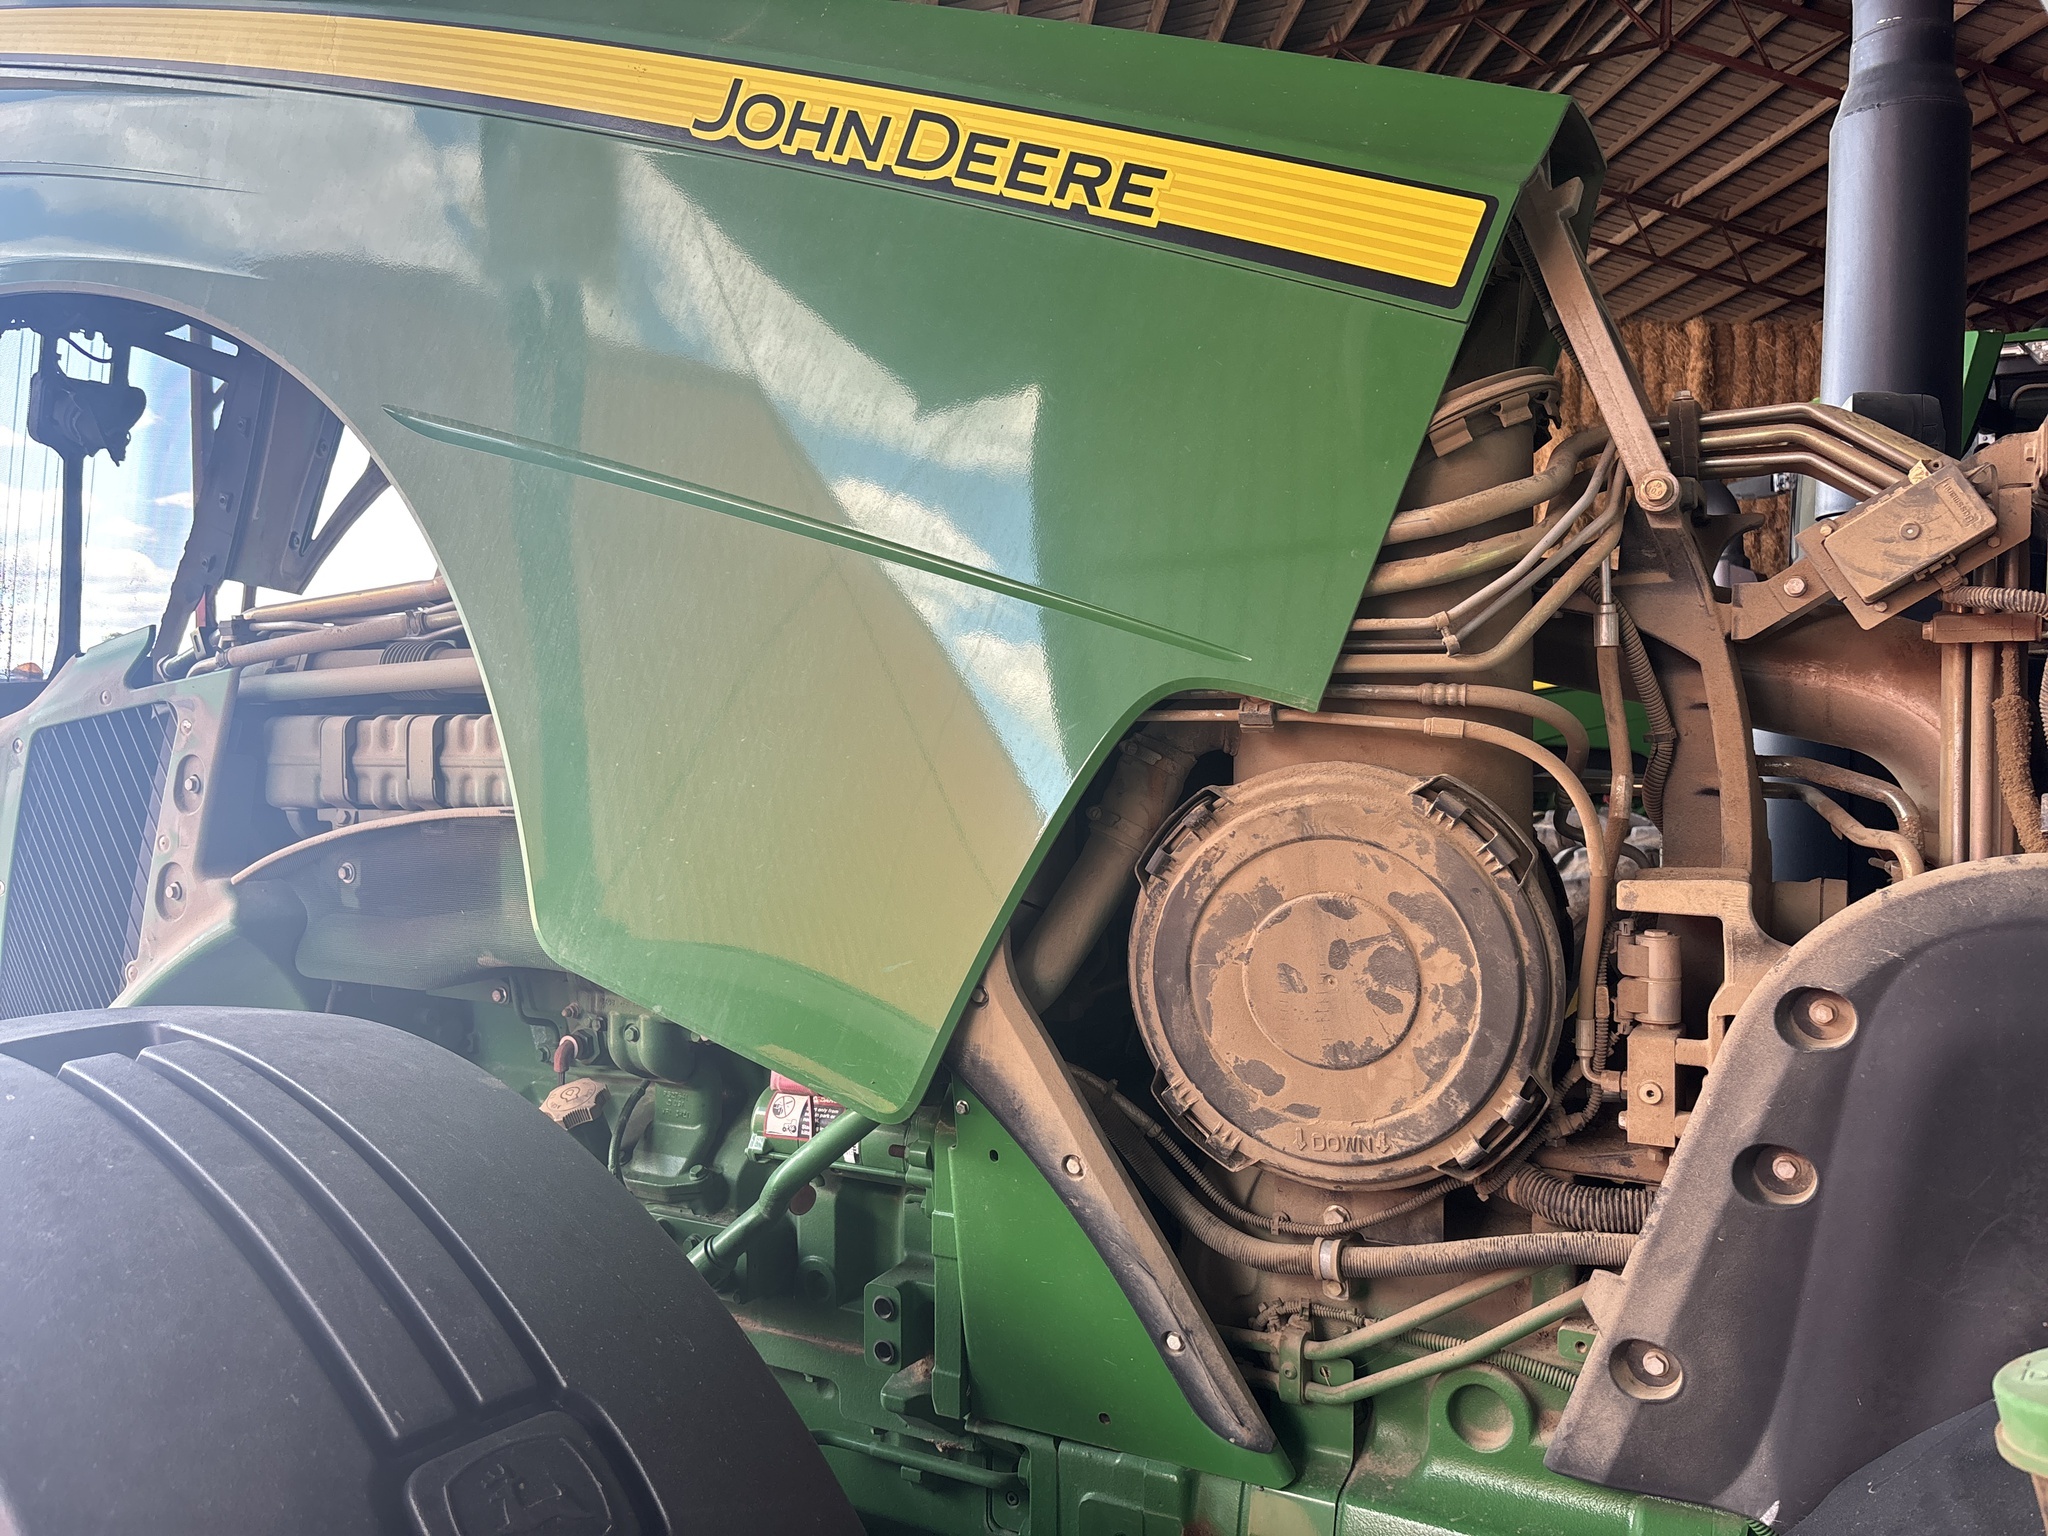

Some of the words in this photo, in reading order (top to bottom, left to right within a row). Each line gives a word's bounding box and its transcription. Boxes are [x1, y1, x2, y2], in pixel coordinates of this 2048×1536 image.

[692, 78, 892, 164] JOHN
[892, 109, 1169, 219] DEERE
[1311, 1131, 1374, 1154] DOWN
